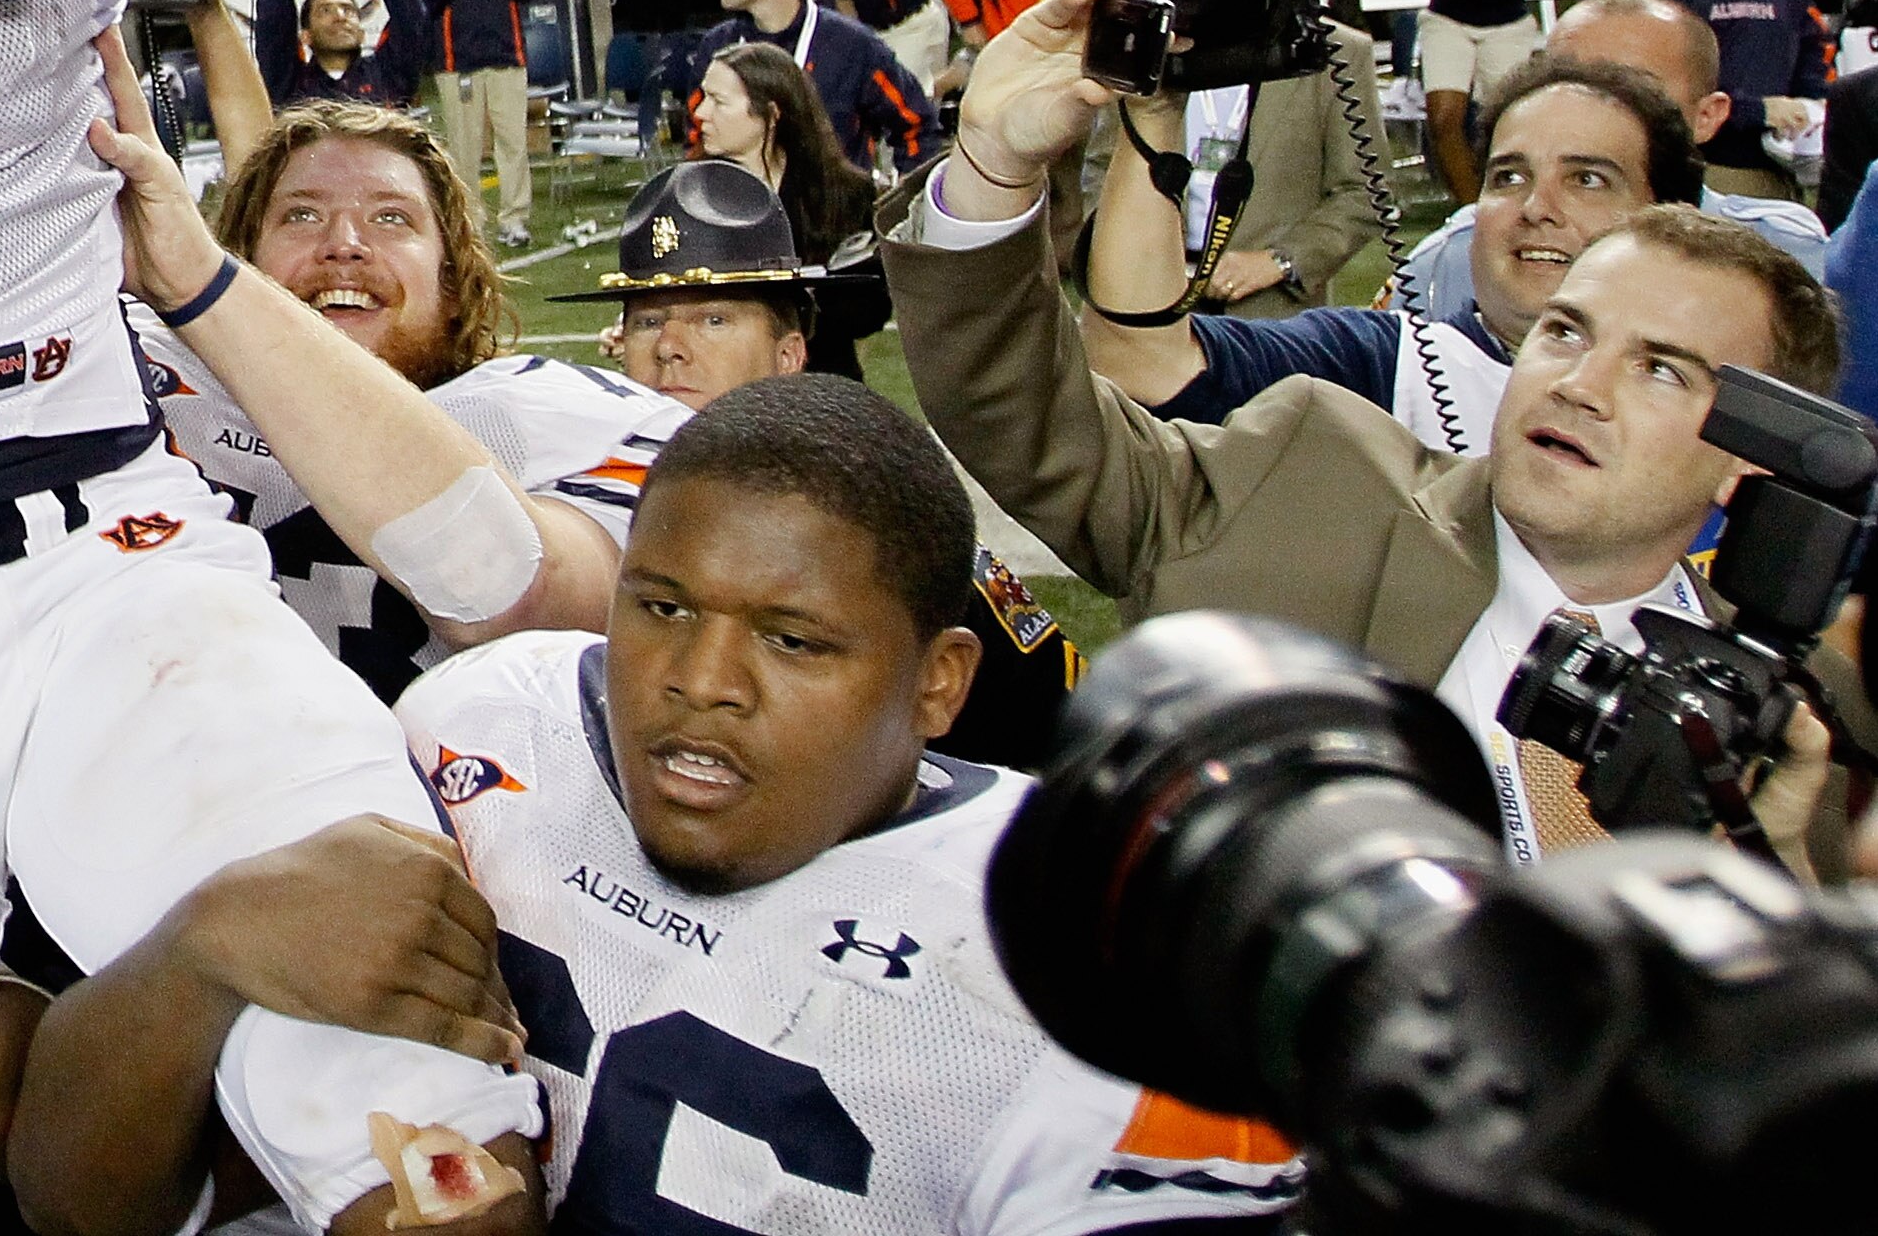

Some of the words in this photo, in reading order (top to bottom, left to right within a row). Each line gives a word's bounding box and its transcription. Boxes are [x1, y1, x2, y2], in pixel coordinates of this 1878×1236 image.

[1709, 1, 1776, 21] AUBURN
[1202, 215, 1232, 275] Nikon
[563, 866, 724, 956] AUBURN
